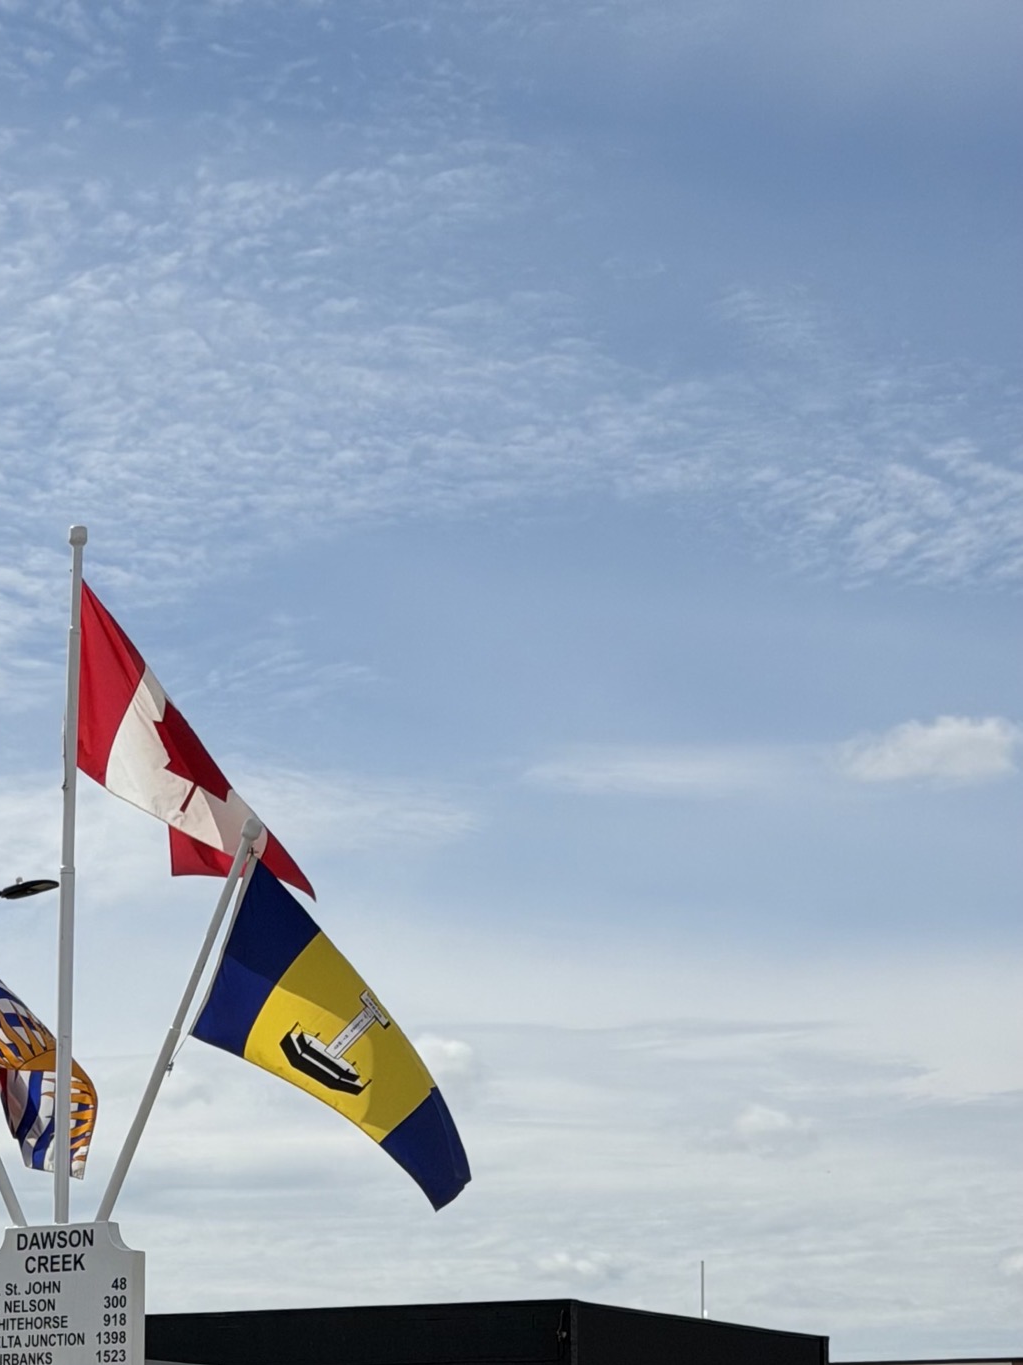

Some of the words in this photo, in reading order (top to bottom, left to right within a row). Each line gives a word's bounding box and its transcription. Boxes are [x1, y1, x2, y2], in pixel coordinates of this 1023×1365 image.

[17, 1229, 94, 1251] DAWSON
[24, 1253, 86, 1274] CREEK
[5, 1282, 21, 1296] St.
[24, 1280, 61, 1295] JOHN
[111, 1277, 127, 1291] 48
[4, 1298, 56, 1314] NELSON
[104, 1295, 127, 1309] 300
[103, 1313, 126, 1327] 918
[24, 1333, 85, 1348] JUNCTION
[95, 1331, 126, 1345] 1398
[95, 1349, 126, 1363] 1523
